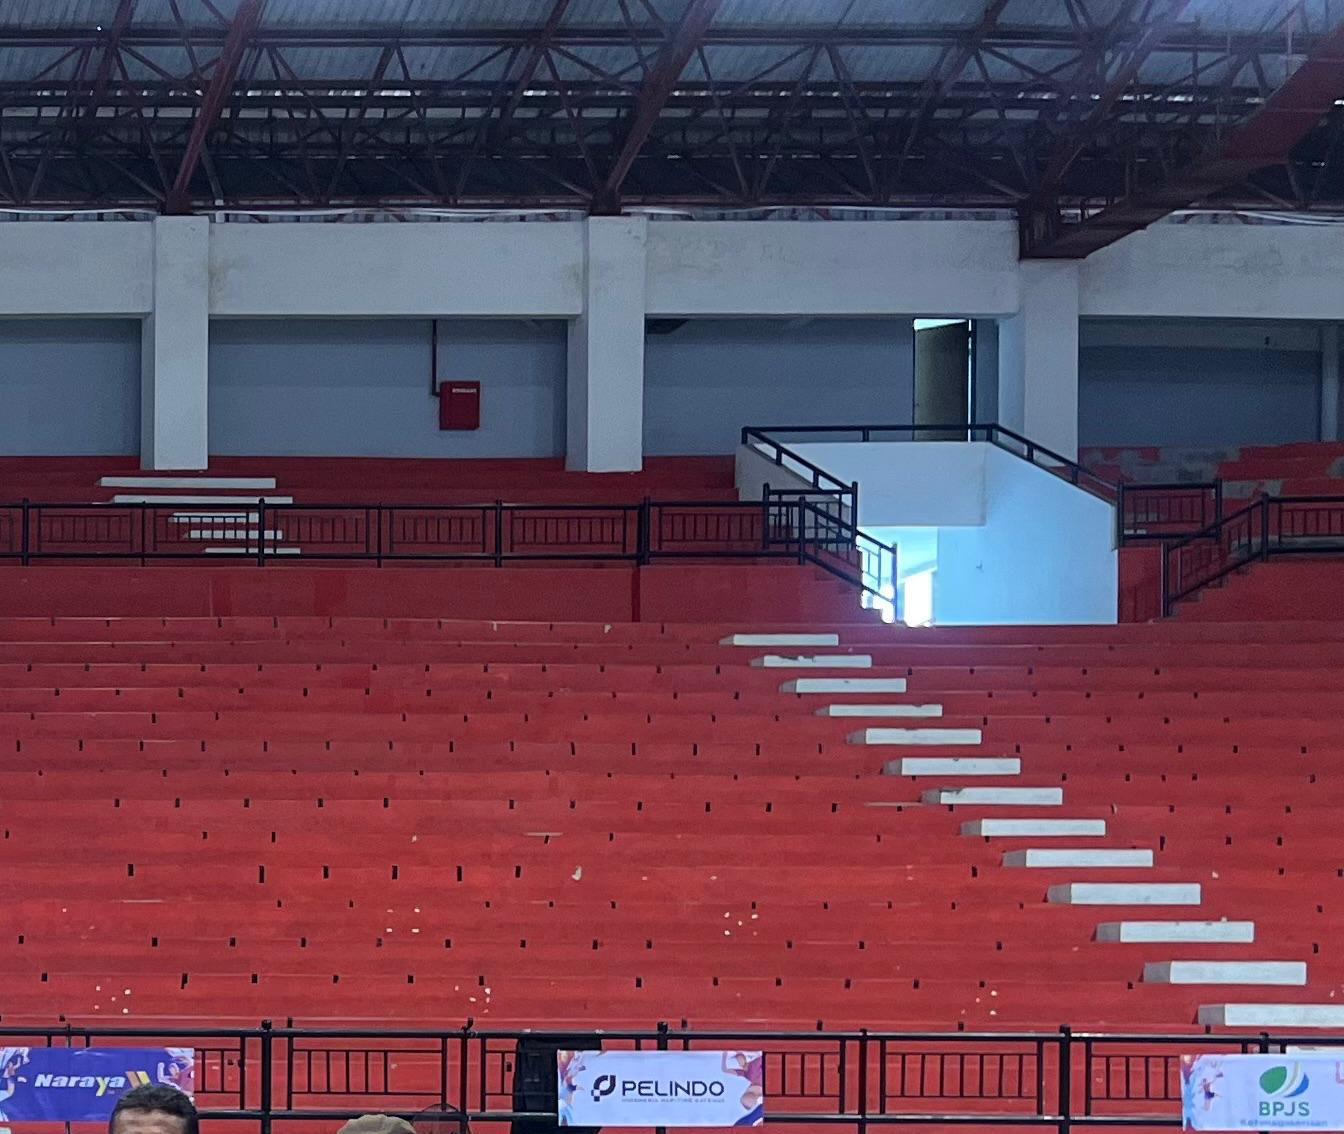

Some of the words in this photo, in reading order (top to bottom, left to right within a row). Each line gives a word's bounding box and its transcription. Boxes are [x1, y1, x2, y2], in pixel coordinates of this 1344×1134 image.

[34, 1073, 126, 1097] Naraya
[621, 1080, 725, 1097] PELINDO
[1258, 1101, 1310, 1117] BPJS
